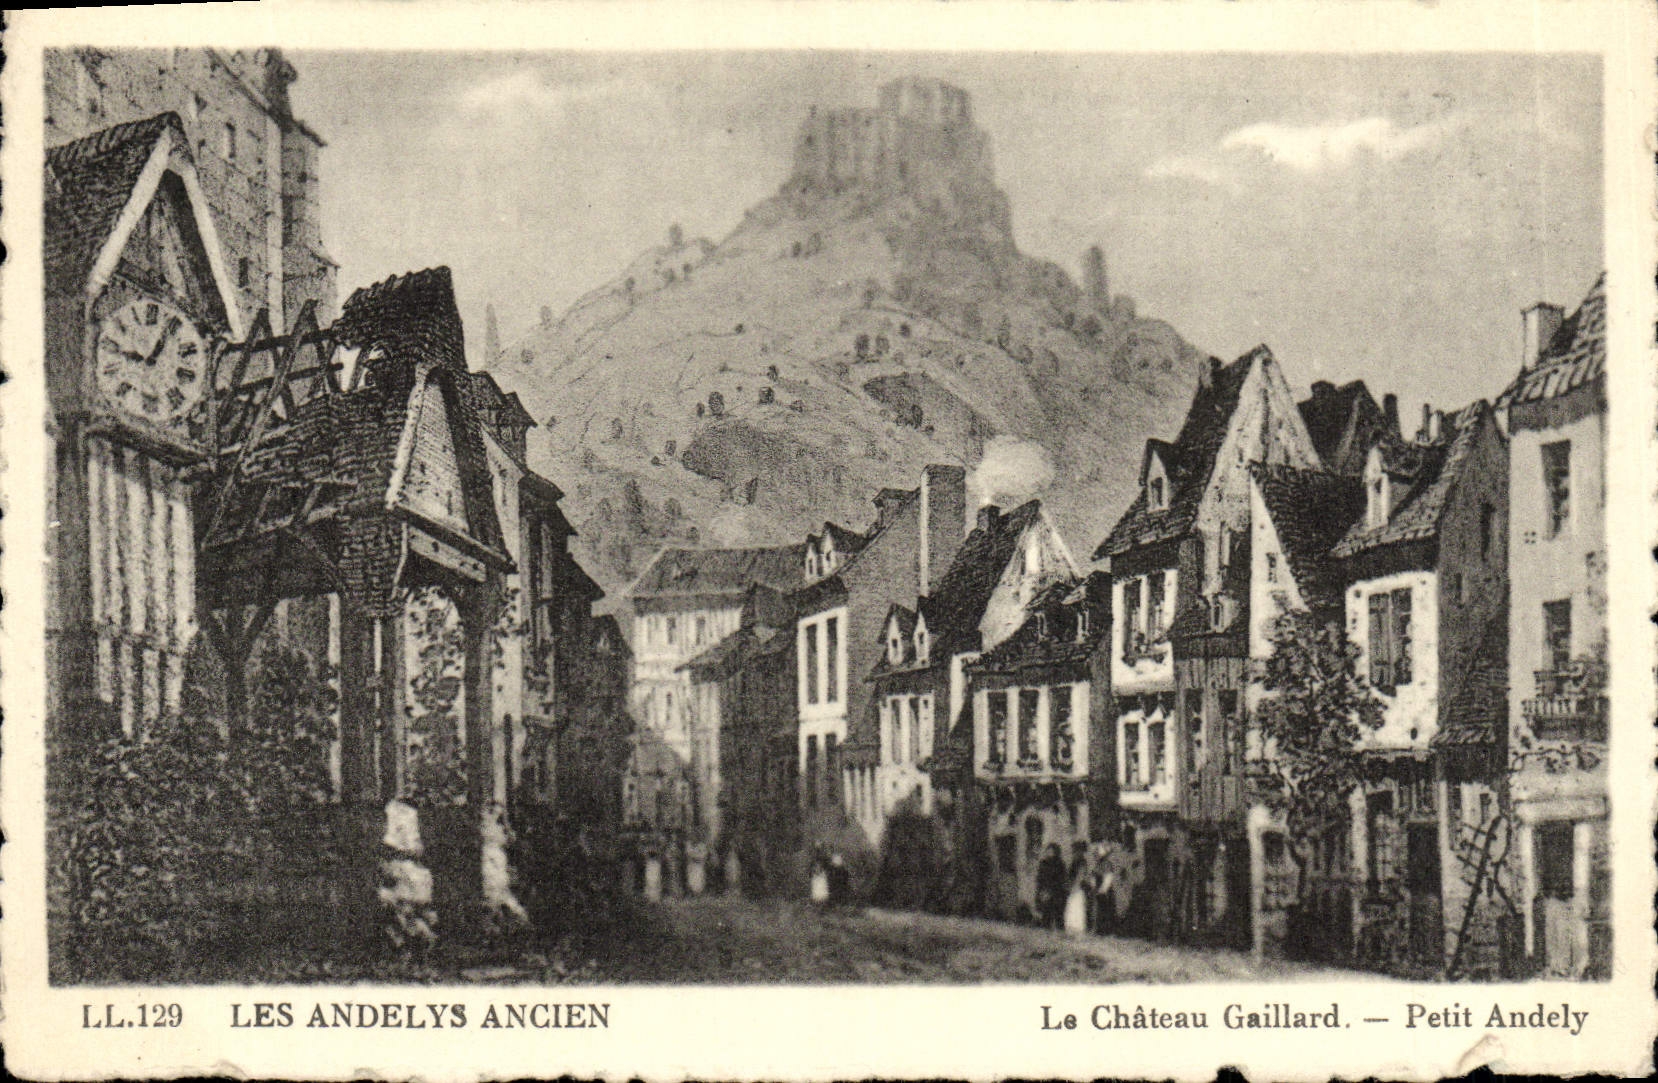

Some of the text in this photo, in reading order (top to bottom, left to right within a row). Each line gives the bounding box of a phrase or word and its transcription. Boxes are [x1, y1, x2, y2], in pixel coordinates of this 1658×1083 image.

[81, 1003, 184, 1029] LL.129
[230, 1003, 611, 1029] LES ANDELYS ANCIEN
[1041, 1005, 1078, 1030] Le
[1091, 1004, 1208, 1030] Château
[1223, 1003, 1351, 1030] Gaillard.
[1405, 1003, 1472, 1029] Petit
[1484, 1003, 1590, 1036] Andely
